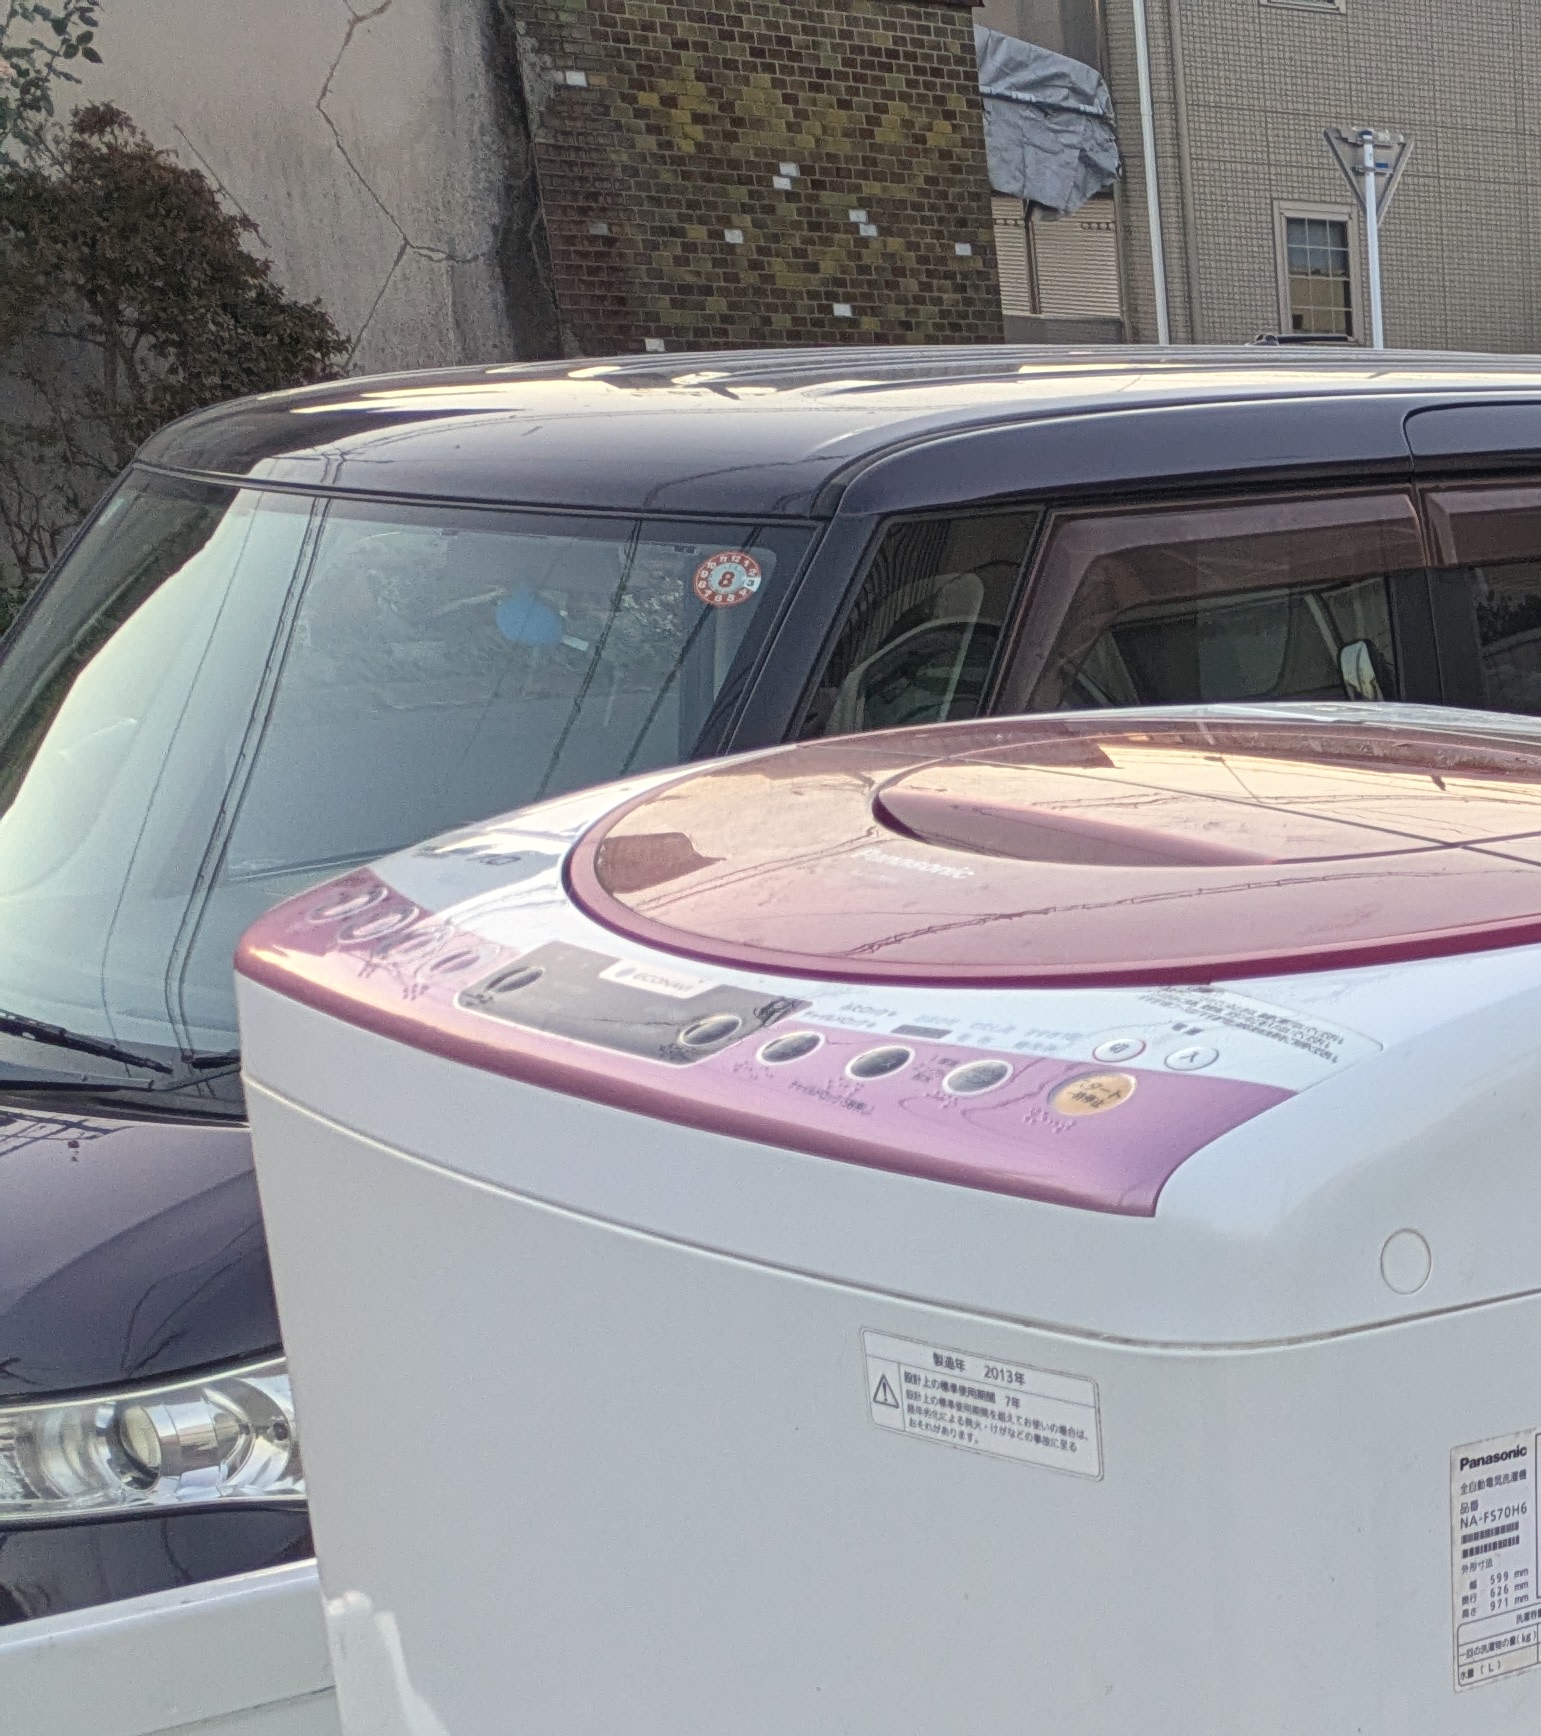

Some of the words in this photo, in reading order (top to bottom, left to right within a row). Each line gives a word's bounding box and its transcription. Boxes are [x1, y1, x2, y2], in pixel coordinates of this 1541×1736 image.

[718, 571, 736, 588] 8
[984, 1365, 1025, 1386] 2013年
[1005, 1396, 1020, 1409] 7年
[1460, 1445, 1527, 1471] Panasonic
[1460, 1501, 1527, 1530] NA-FS70H6
